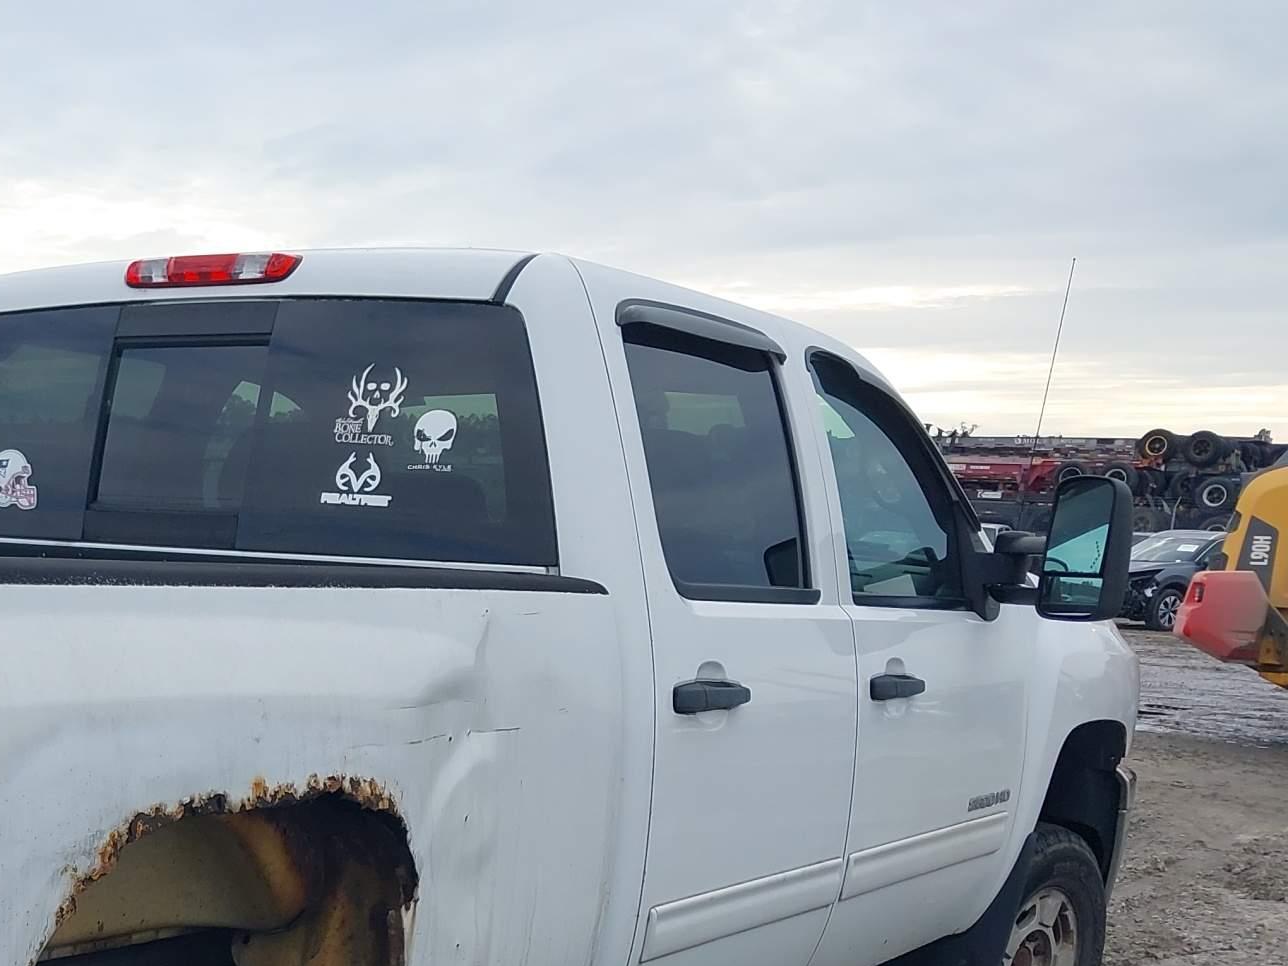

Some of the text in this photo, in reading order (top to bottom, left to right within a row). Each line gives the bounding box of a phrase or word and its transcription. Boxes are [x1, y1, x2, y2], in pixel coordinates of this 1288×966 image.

[333, 422, 362, 434] BONE
[335, 432, 394, 446] COLLECTOR
[1249, 535, 1273, 566] L90H
